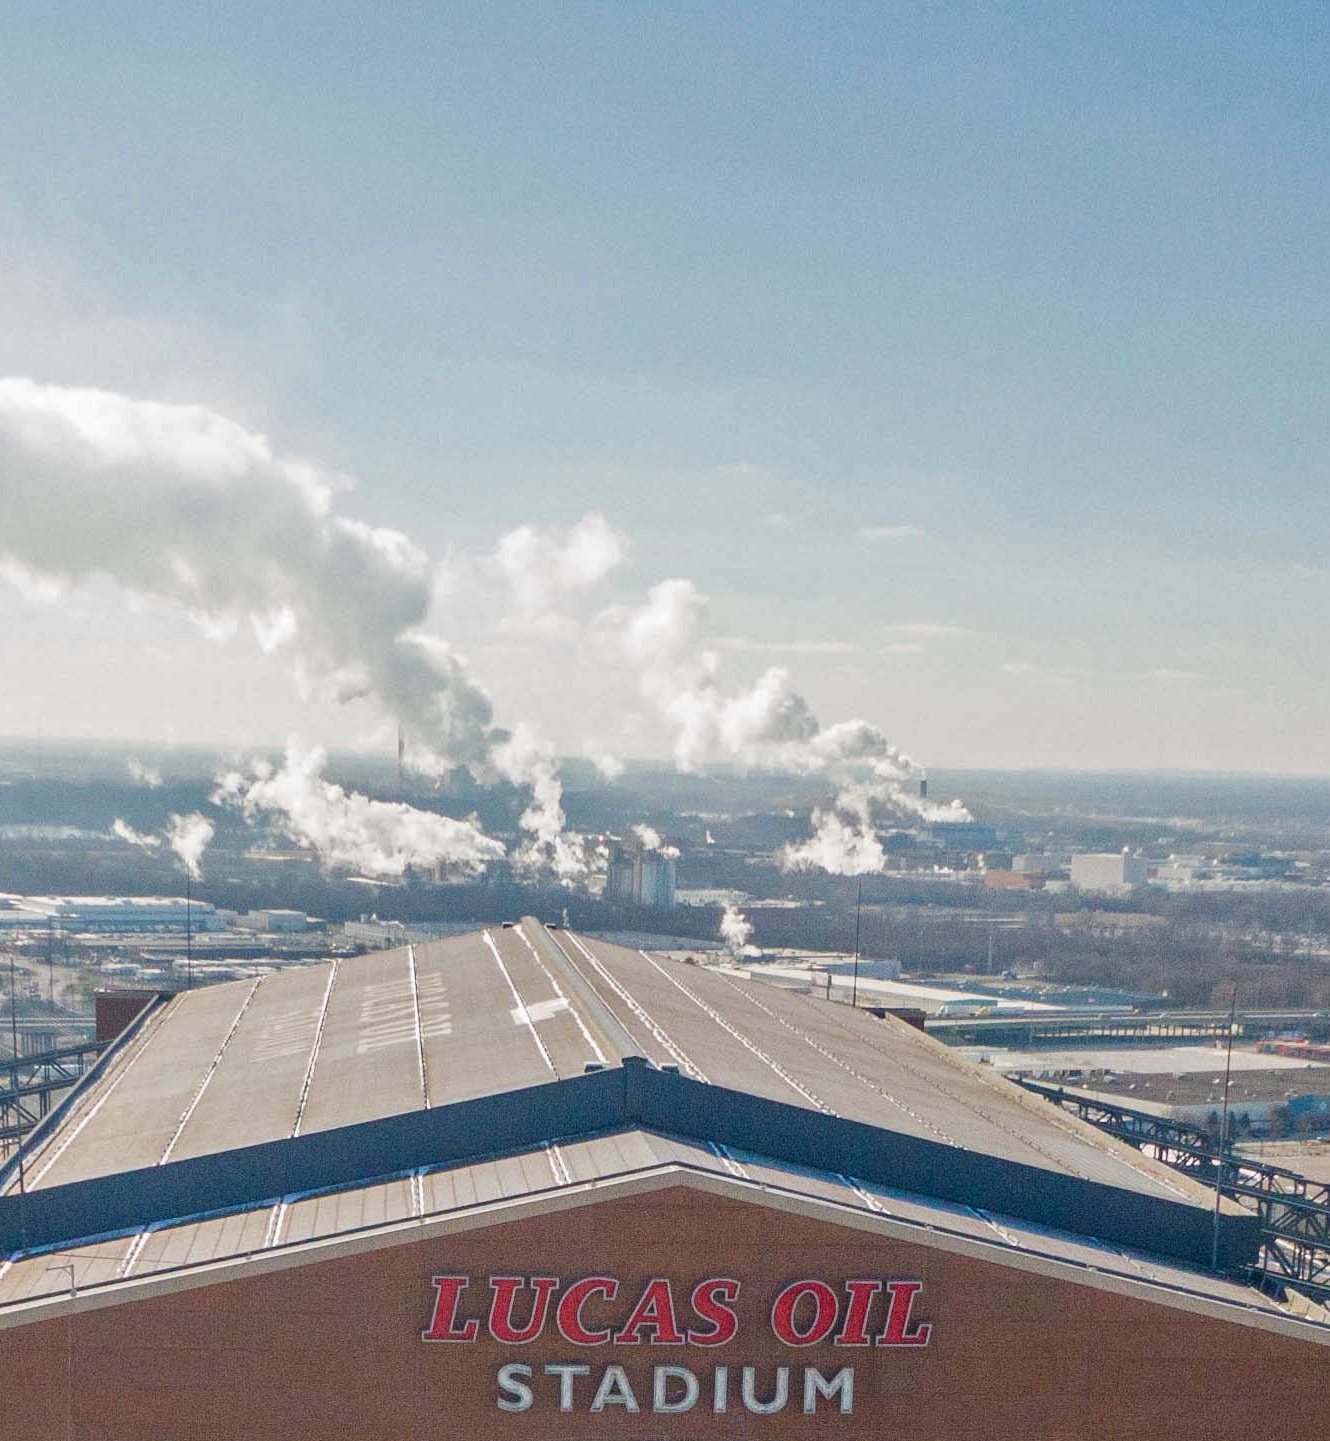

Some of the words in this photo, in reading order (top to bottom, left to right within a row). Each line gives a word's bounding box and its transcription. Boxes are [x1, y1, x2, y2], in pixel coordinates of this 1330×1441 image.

[421, 1275, 741, 1347] LUCAS
[770, 1279, 933, 1348] OIL
[496, 1364, 855, 1415] STADIUM
